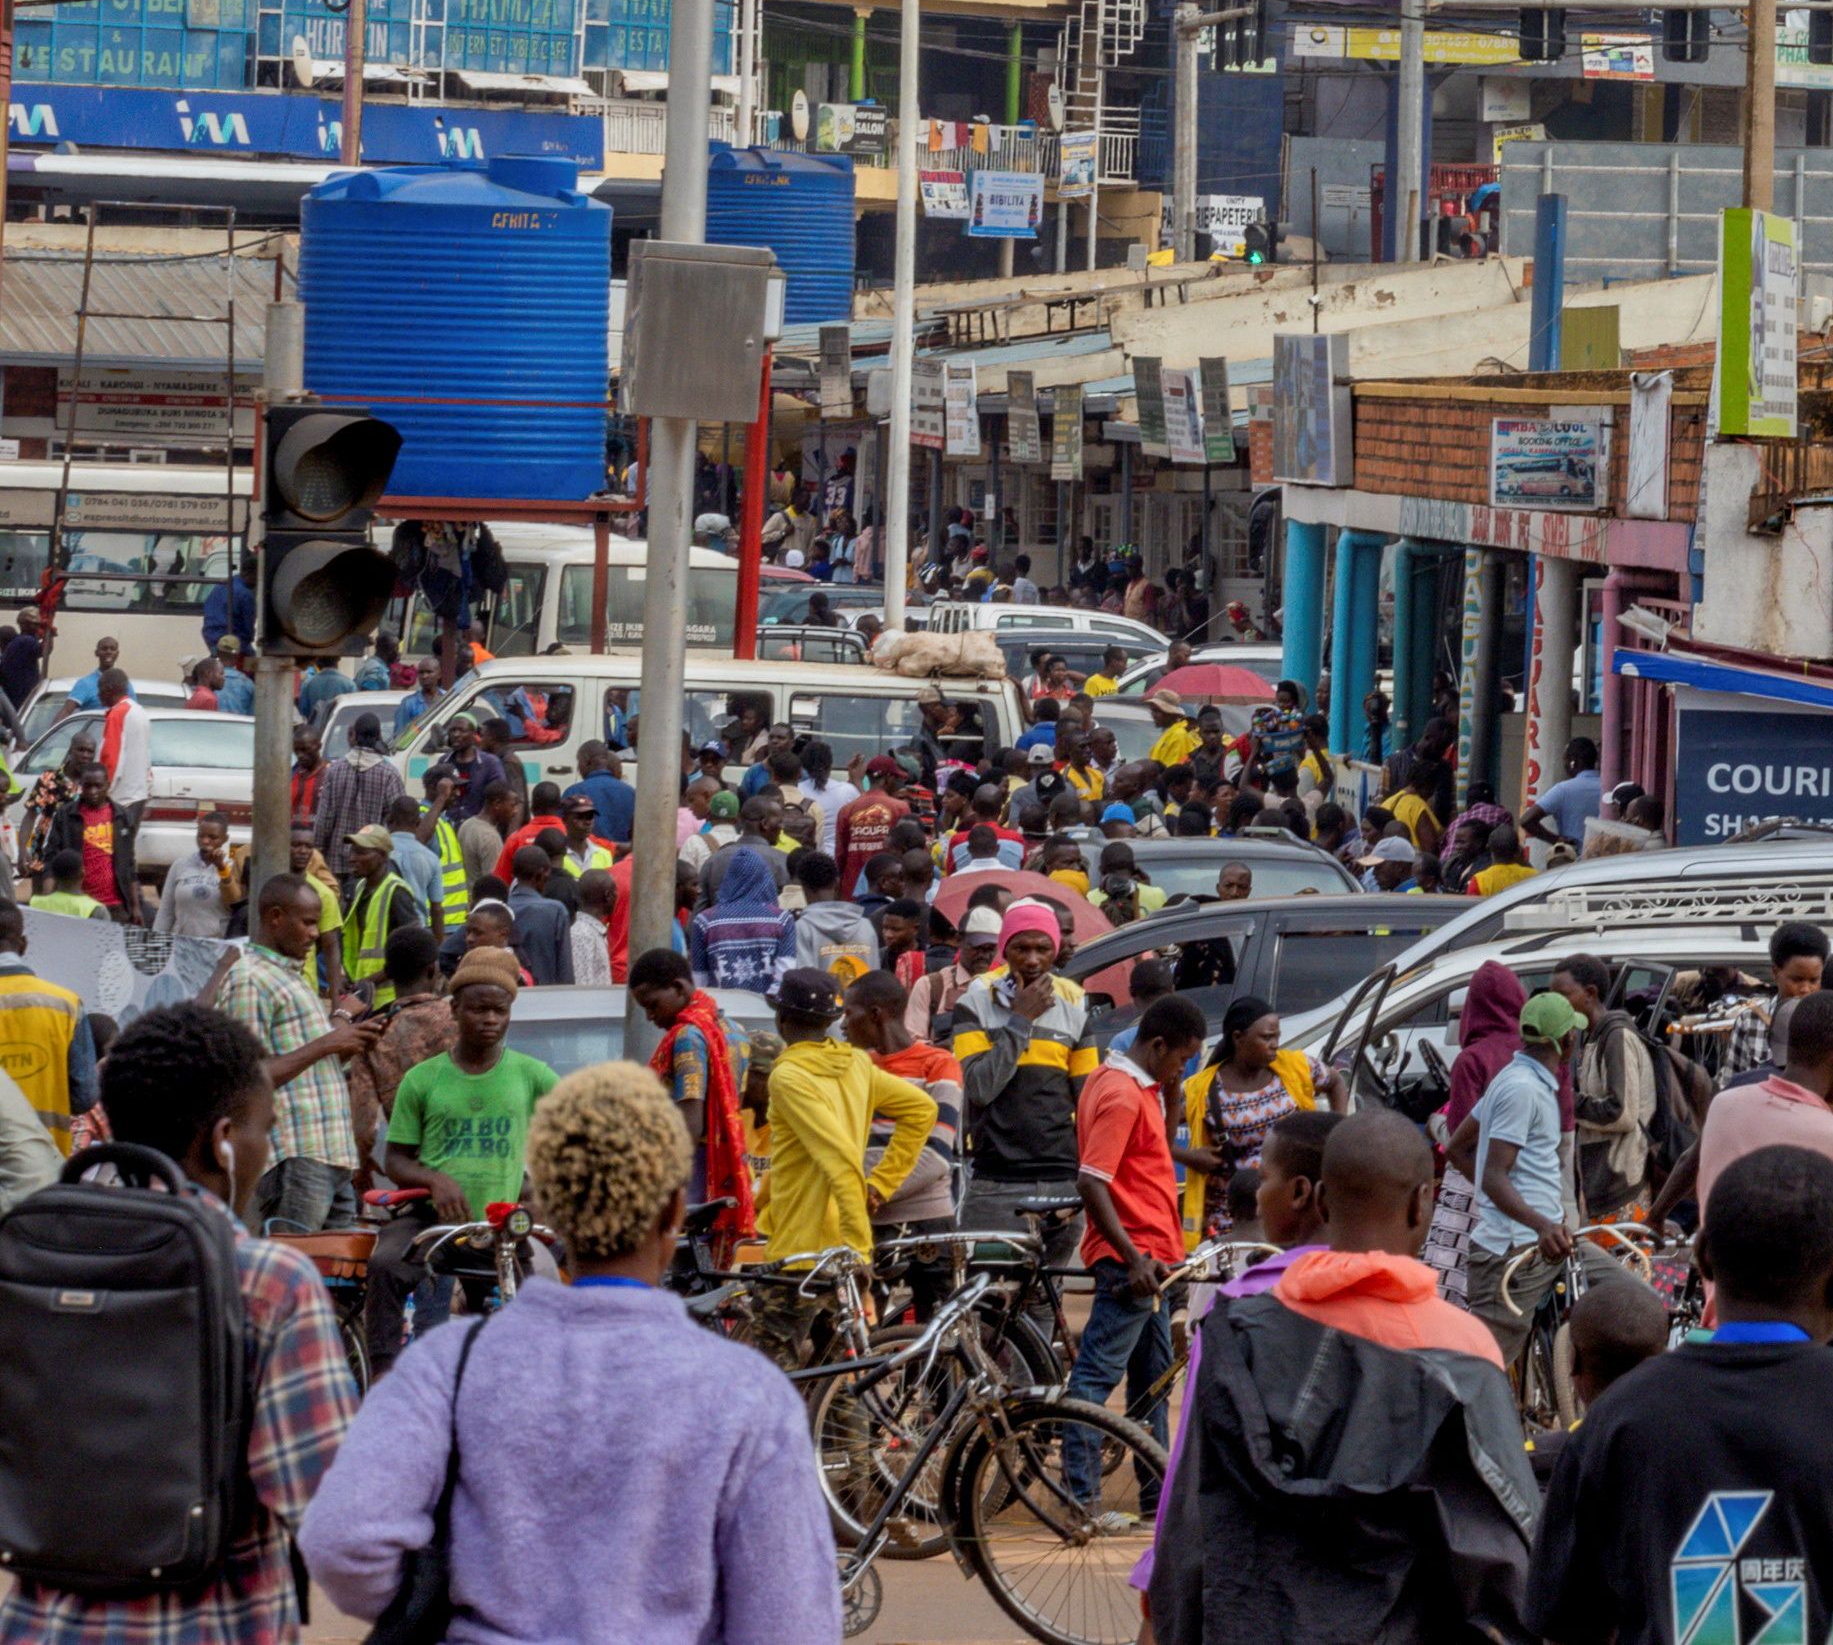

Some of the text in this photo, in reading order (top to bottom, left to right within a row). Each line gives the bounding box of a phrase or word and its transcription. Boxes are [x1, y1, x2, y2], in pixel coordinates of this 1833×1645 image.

[16, 42, 208, 78] RESTAURANT
[855, 121, 885, 135] SALON
[1554, 421, 1588, 434] COOL
[1518, 436, 1583, 446] BOOKING OFFICE
[825, 485, 848, 508] 33
[1741, 1559, 1807, 1584] 周年庆
